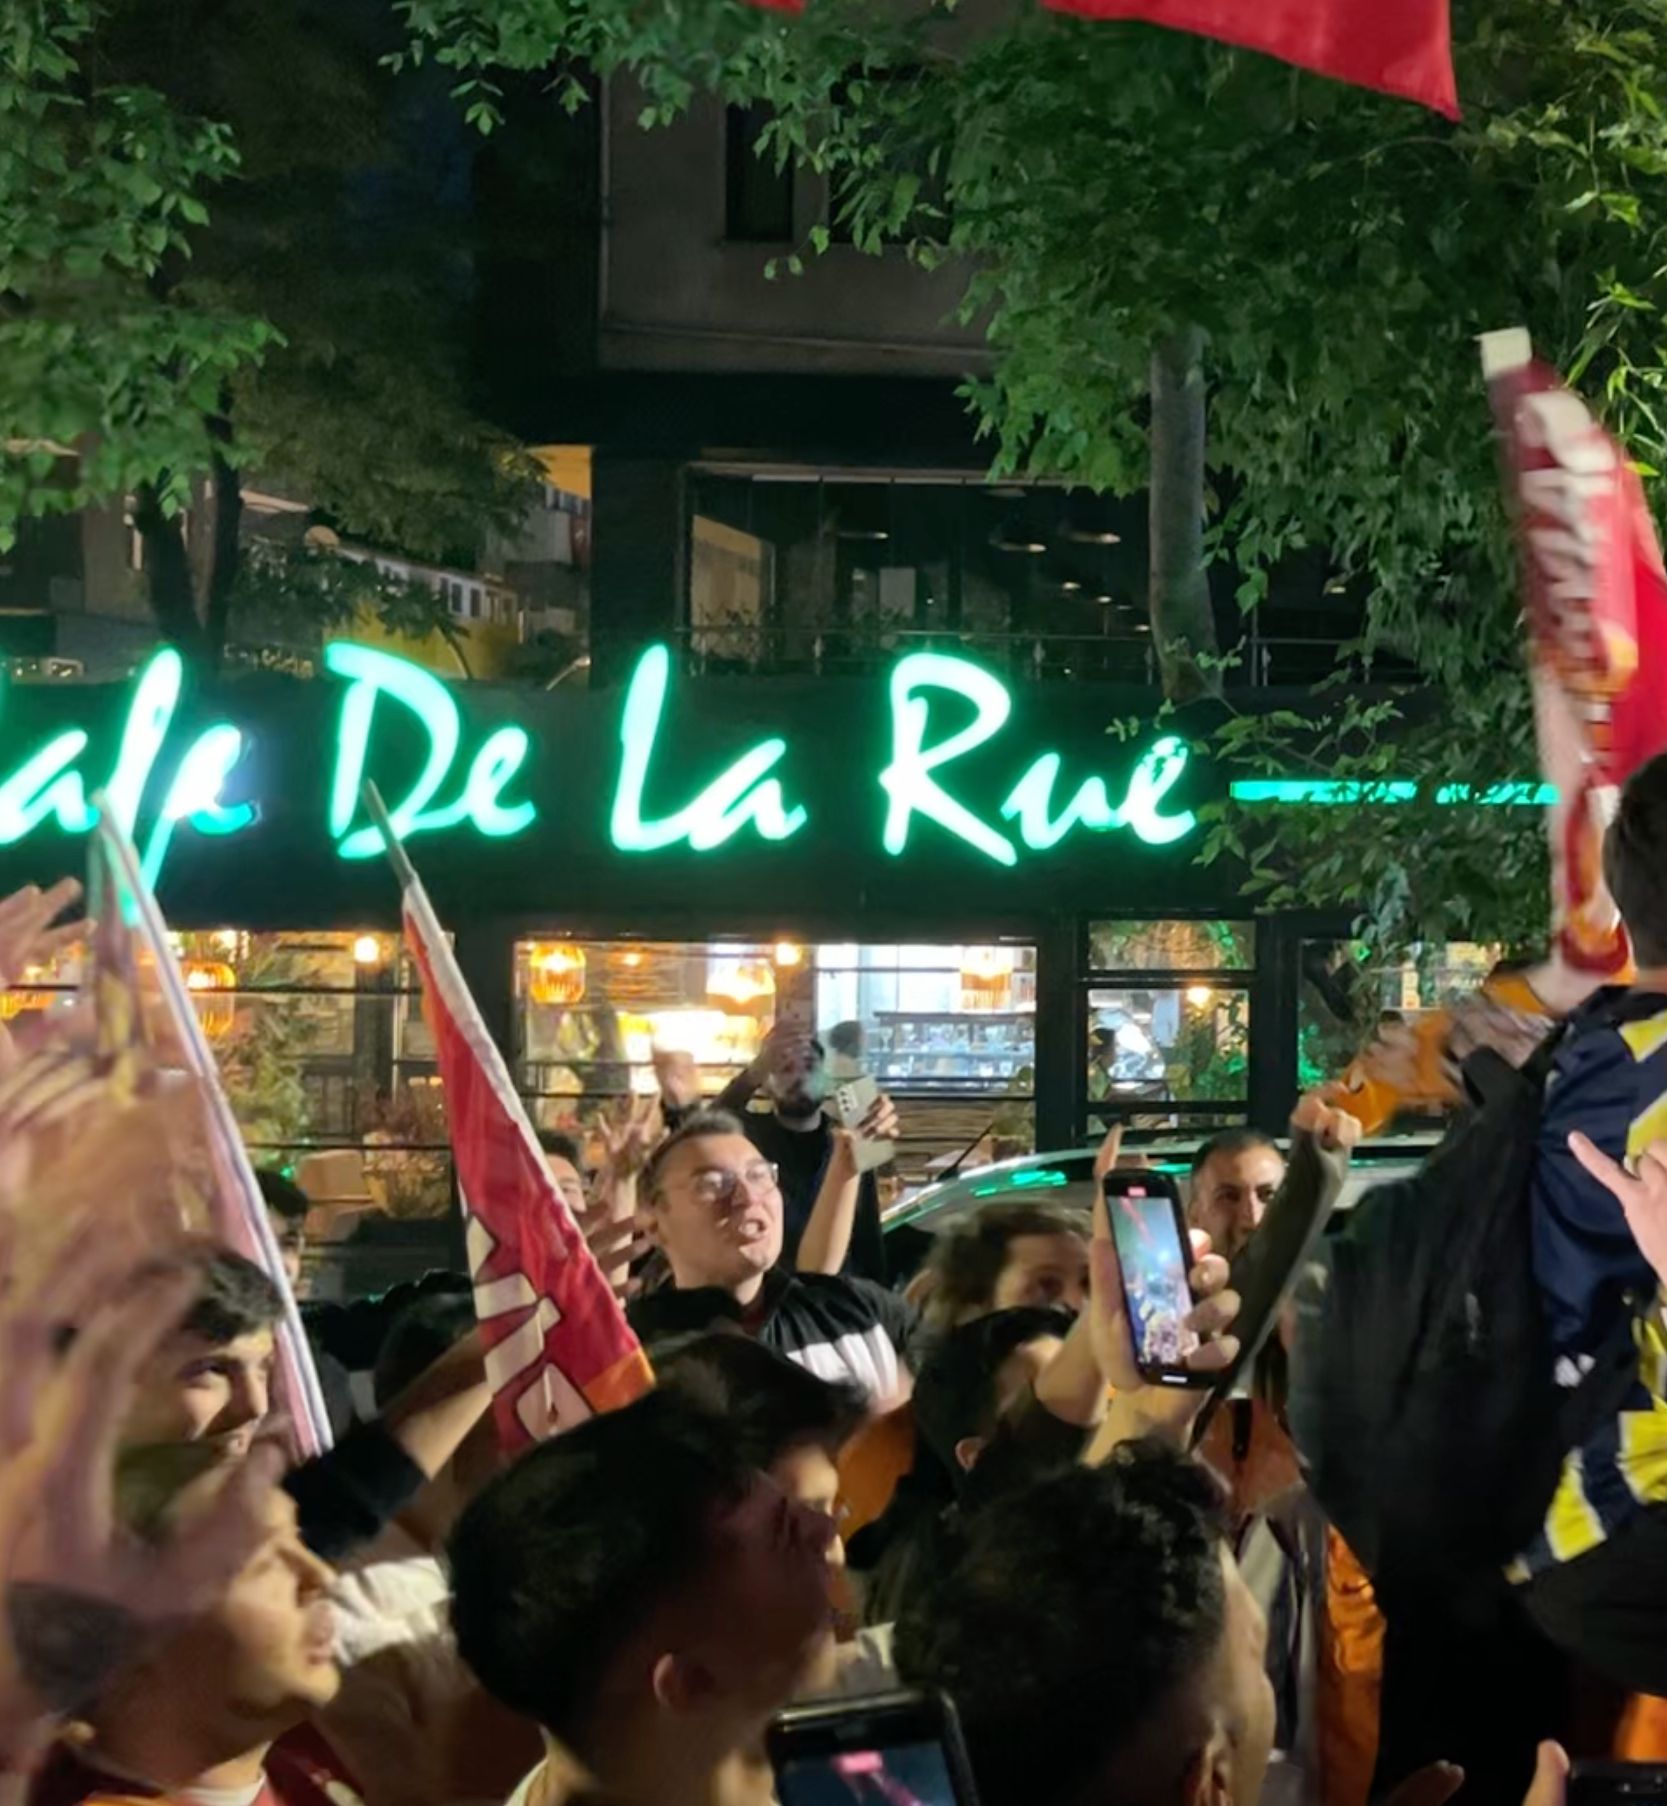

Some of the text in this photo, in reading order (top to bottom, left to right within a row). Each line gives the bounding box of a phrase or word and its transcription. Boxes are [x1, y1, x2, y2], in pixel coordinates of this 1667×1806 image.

[0, 640, 1197, 928] afe De La Rue
